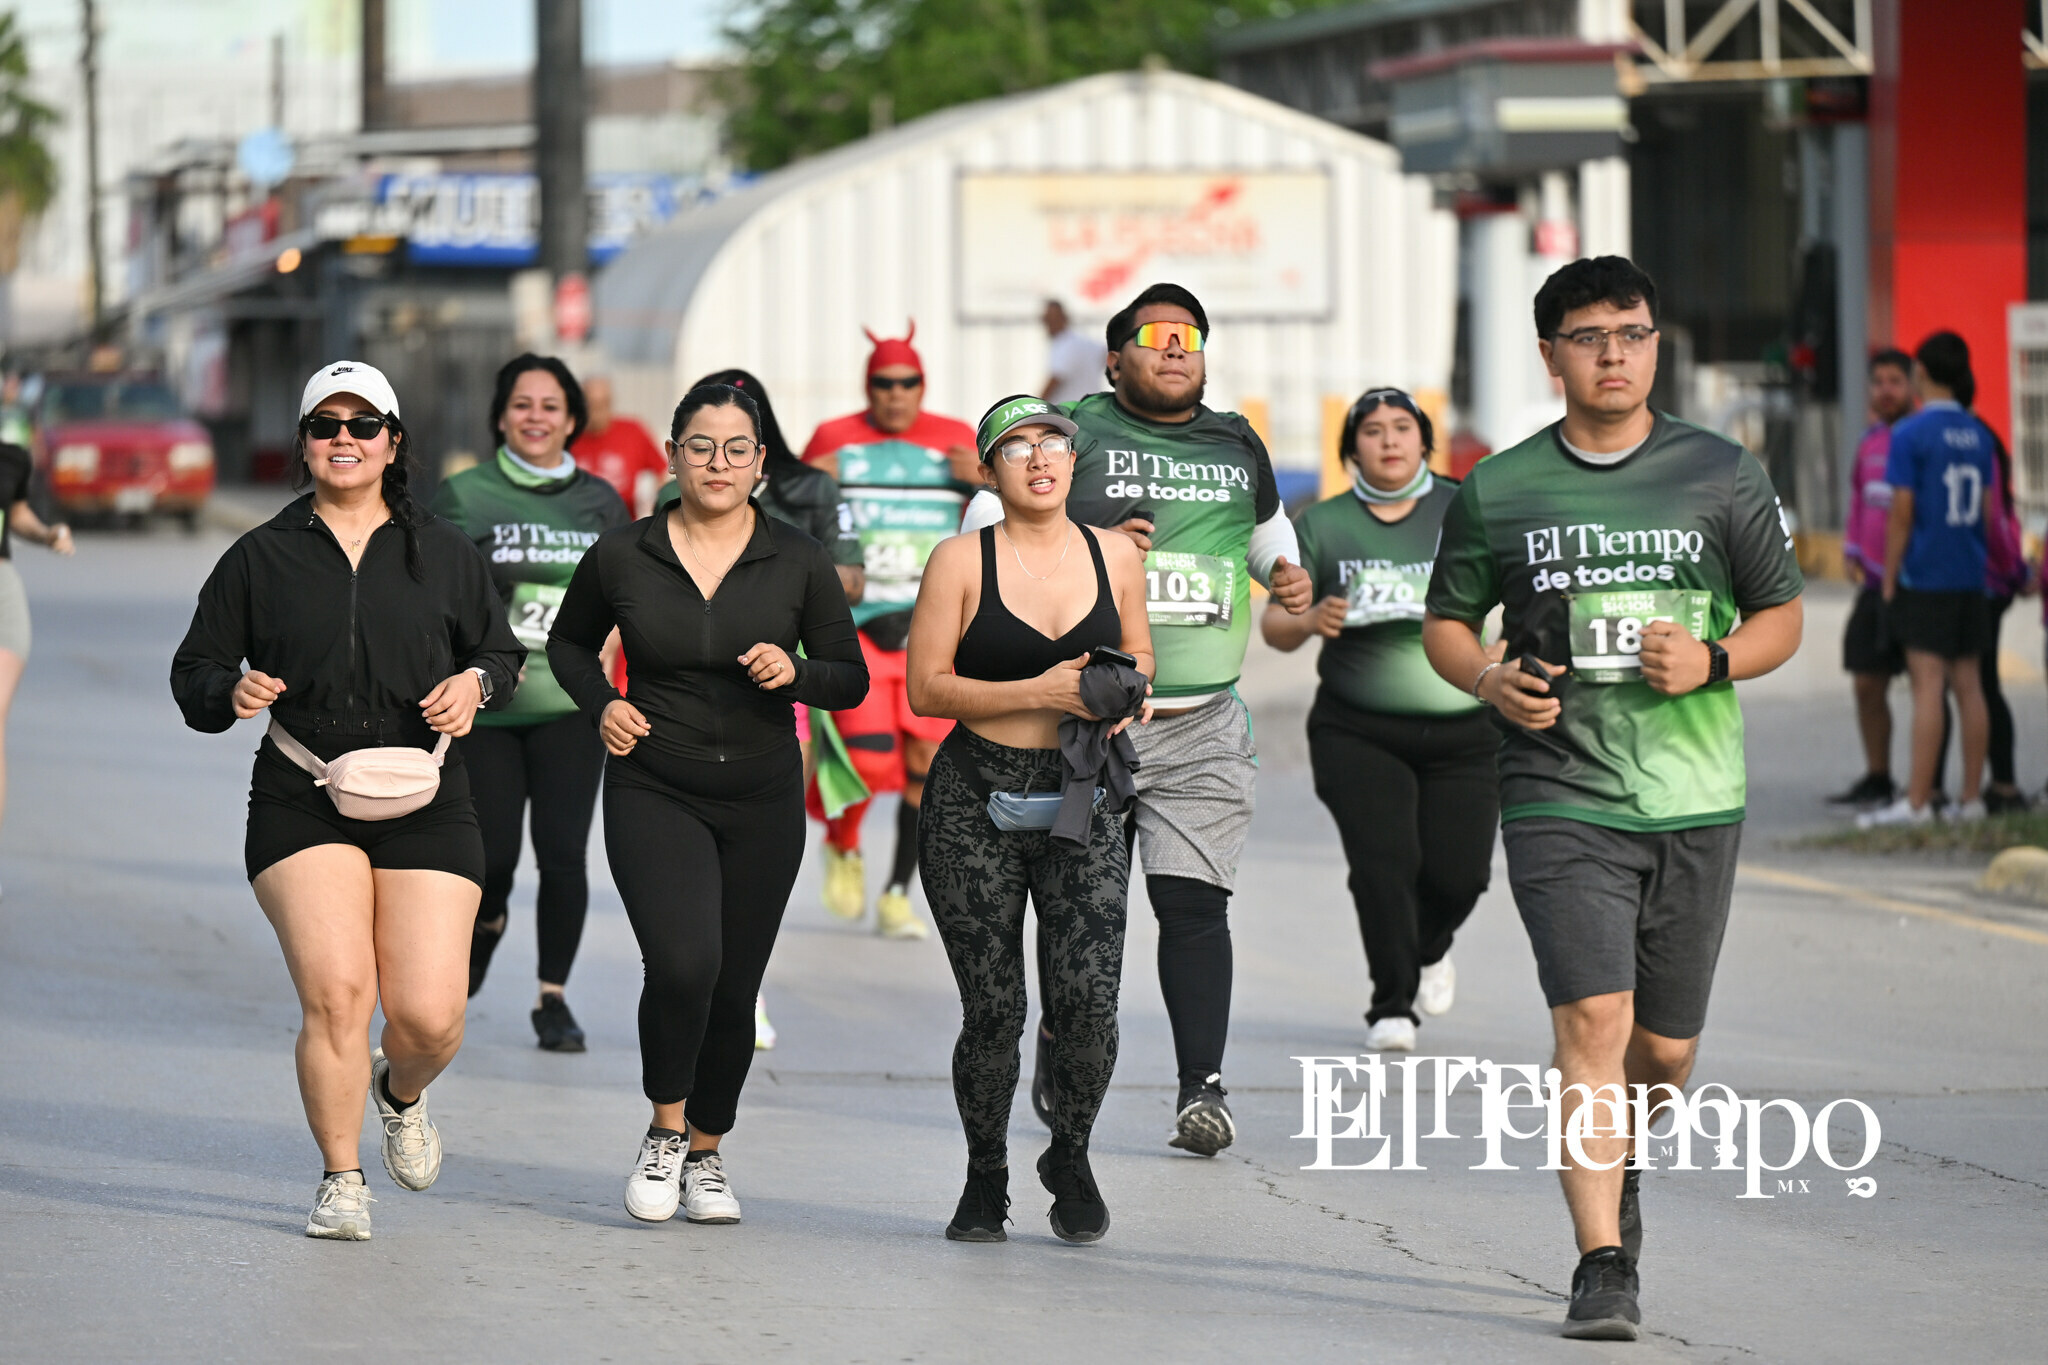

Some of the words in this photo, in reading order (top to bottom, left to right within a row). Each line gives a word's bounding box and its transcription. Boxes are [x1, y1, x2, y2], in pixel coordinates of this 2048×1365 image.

[1105, 449, 1140, 476] El
[1143, 453, 1249, 488] Tiempo
[1105, 480, 1144, 498] de
[1147, 482, 1231, 502] todos
[1942, 463, 1982, 527] 10
[493, 523, 520, 545] El
[521, 523, 600, 547] Tiem
[1523, 525, 1563, 566] El
[1566, 523, 1704, 562] Tiempo
[491, 546, 524, 563] de
[526, 546, 588, 563] todo
[1146, 571, 1211, 601] 103
[1532, 569, 1571, 593] de
[1574, 561, 1675, 587] todos
[1221, 572, 1233, 620] MEDALLA
[1356, 582, 1414, 607] 270
[1589, 616, 1674, 654] 18
